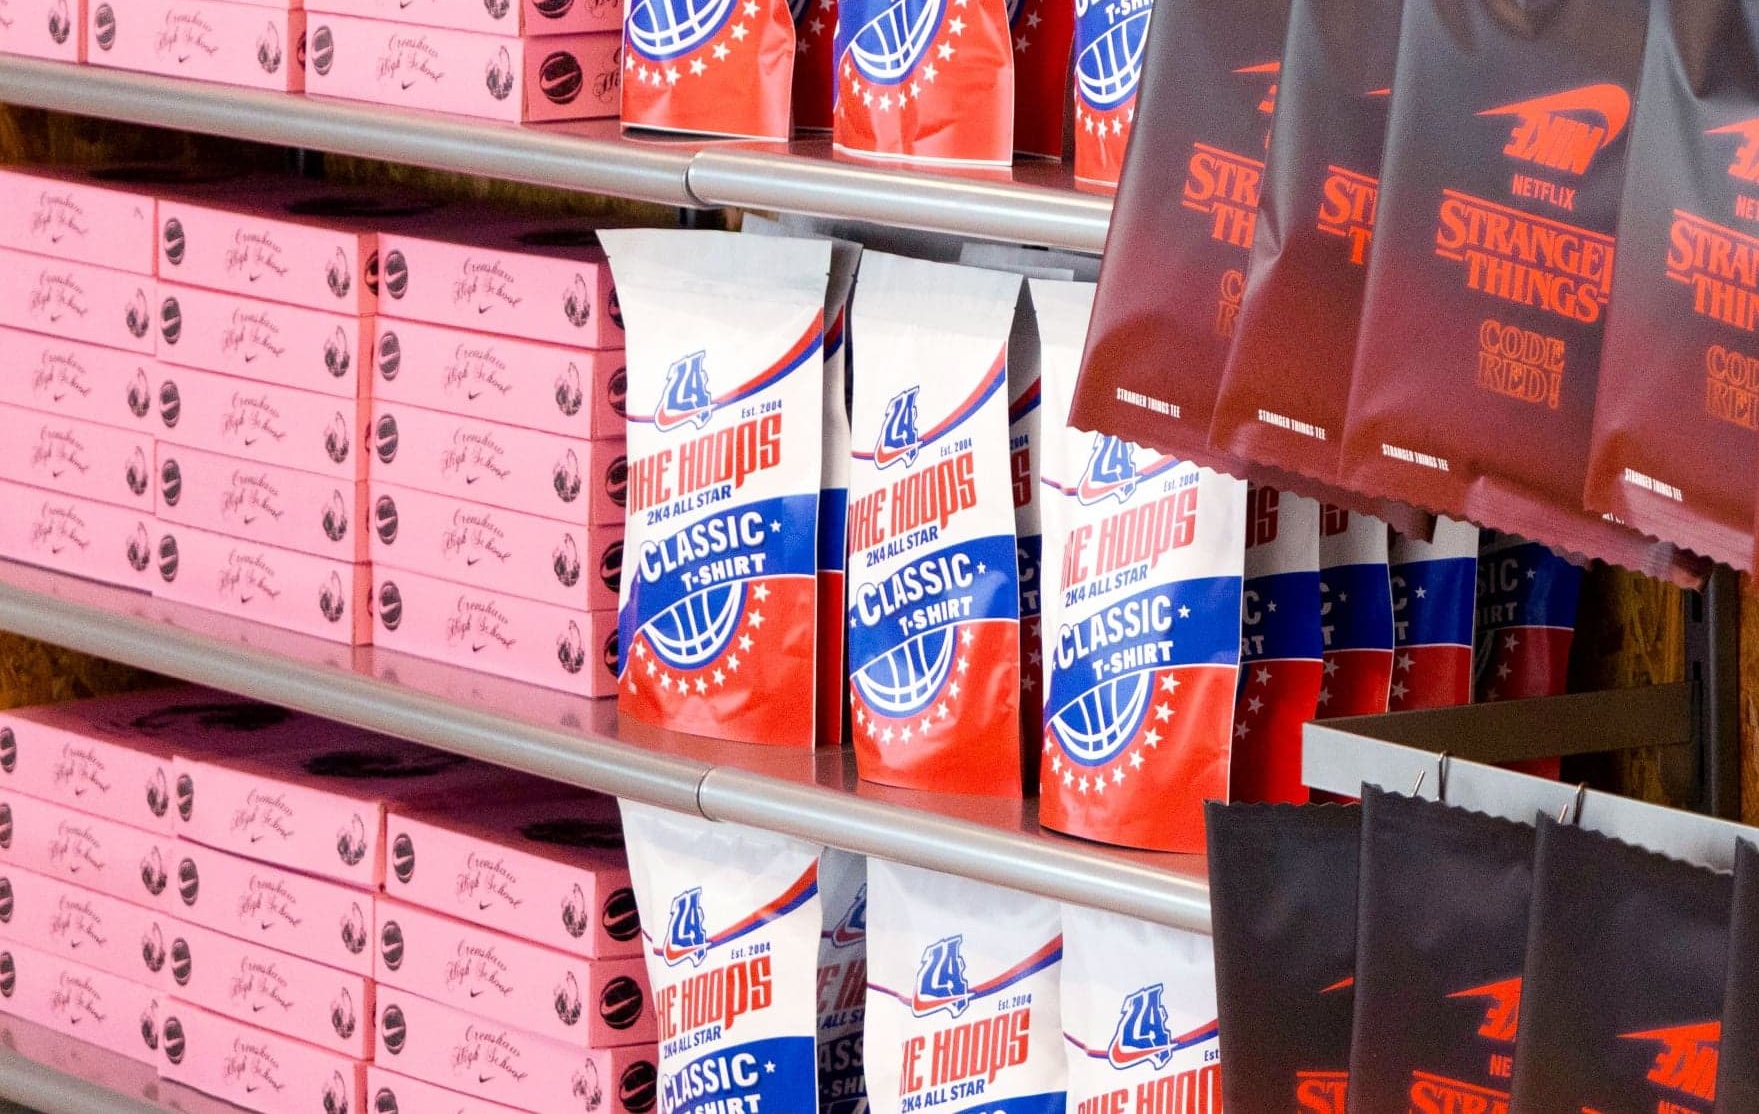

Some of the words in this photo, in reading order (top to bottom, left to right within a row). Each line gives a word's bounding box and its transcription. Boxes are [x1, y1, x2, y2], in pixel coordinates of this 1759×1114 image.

[1511, 174, 1575, 211] NETFLIX
[1465, 251, 1600, 324] THINGS
[1479, 319, 1565, 368] CODE
[678, 413, 782, 497] HOOPS
[647, 504, 670, 526] 2K4
[672, 496, 694, 519] ALL
[696, 485, 731, 510] STAR
[890, 451, 977, 541] HOOPS
[639, 511, 764, 584] CLASSIC
[866, 545, 885, 568] 2K4
[886, 537, 905, 559] ALL
[906, 525, 938, 550] STAR
[682, 553, 766, 591] T-SHIRT
[855, 553, 974, 627] CLASSIC
[1065, 584, 1086, 608] 2K4
[1088, 575, 1113, 600] ALL
[1115, 564, 1148, 589] STAR
[899, 596, 973, 637] T-SHIRT
[1056, 595, 1172, 670] CLASSIC
[1092, 640, 1173, 681] T-SHIRT
[749, 942, 771, 956] 2004
[681, 955, 772, 1035] HOOPS
[678, 1035, 692, 1053] ALL
[693, 1026, 722, 1047] STAR
[931, 1008, 1030, 1086] HOOPS
[662, 1052, 759, 1110] CLASSIC
[901, 1092, 921, 1114] 2K4
[924, 1087, 947, 1107] ALL
[950, 1078, 985, 1100] STAR
